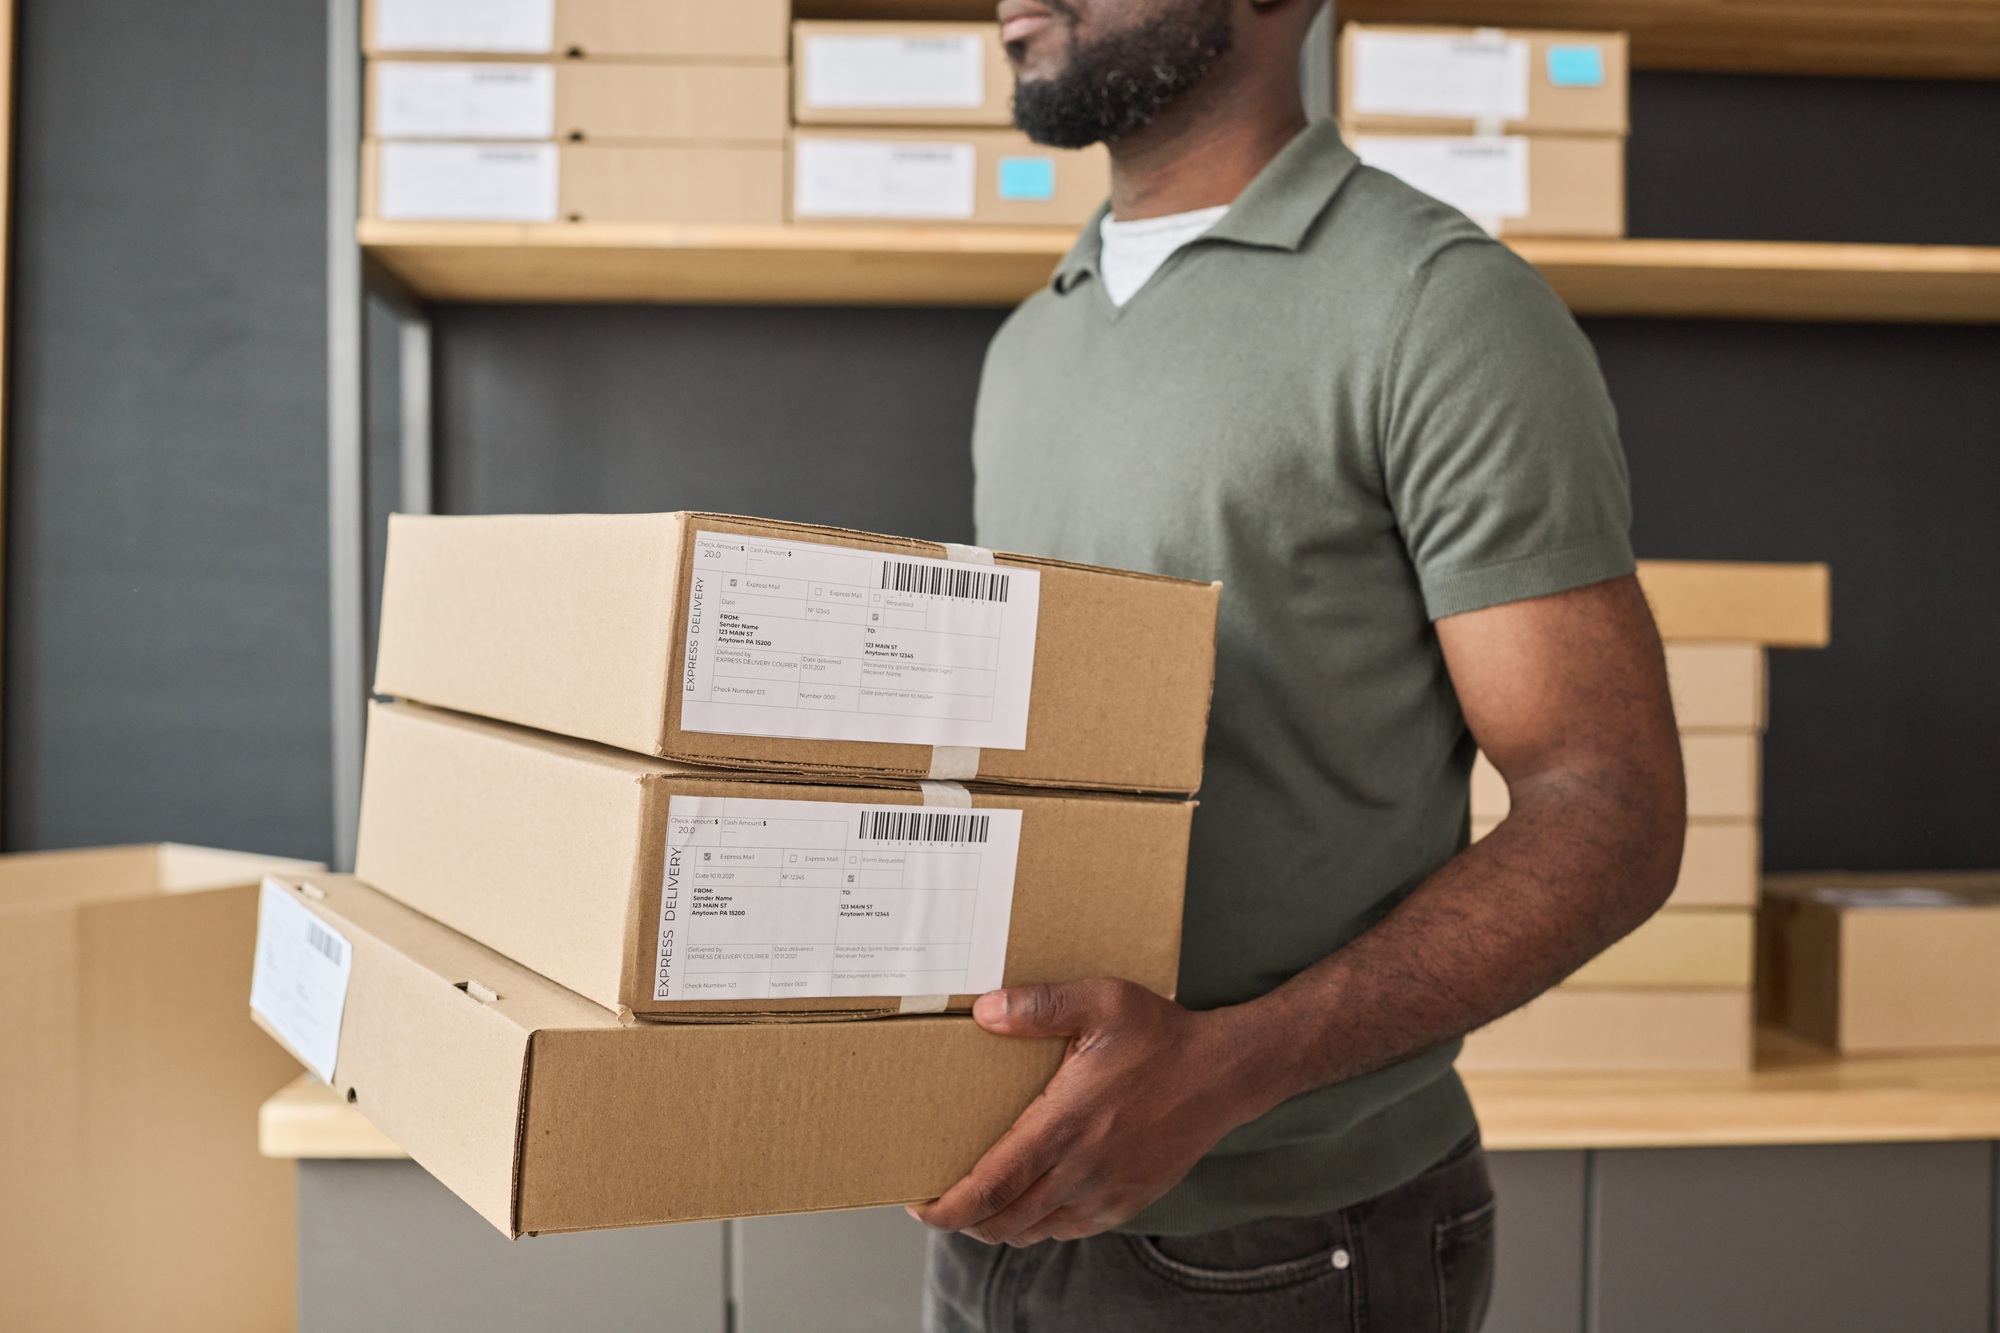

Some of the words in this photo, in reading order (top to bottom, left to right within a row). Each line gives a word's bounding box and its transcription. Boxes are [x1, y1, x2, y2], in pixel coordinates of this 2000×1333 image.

[704, 550, 721, 558] 20.0
[746, 581, 768, 590] Express
[691, 577, 704, 634] DELIVERY
[718, 636, 744, 644] Anytown
[686, 640, 698, 692] EXPRESS
[743, 658, 770, 666] DELIVERY
[665, 847, 681, 921] DELIVERY
[658, 930, 674, 996] EXPRESS
